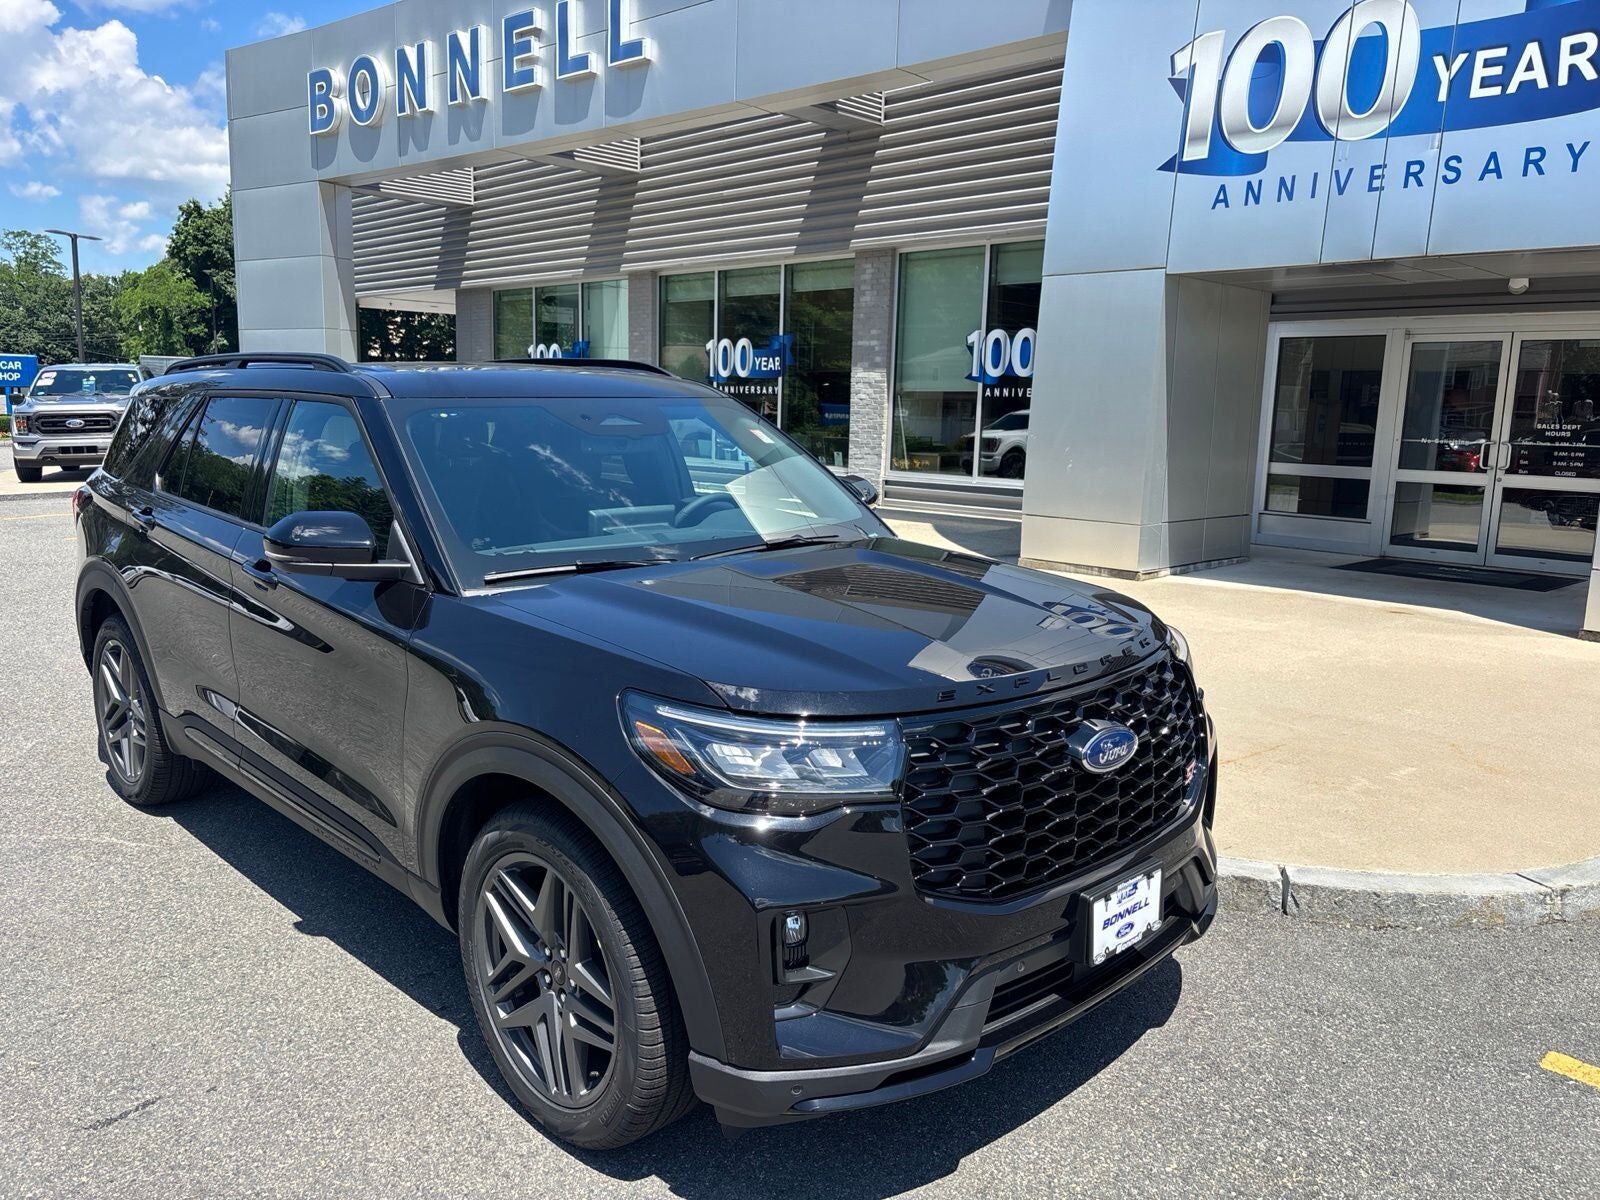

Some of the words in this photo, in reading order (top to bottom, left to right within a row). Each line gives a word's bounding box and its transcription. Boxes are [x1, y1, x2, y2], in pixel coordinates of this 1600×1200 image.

[307, 0, 652, 135] BONNELL
[1172, 0, 1420, 162] 100
[1432, 31, 1598, 103] YEAR
[1211, 140, 1591, 210] ANNIVERSARY
[0, 361, 22, 370] CAR
[705, 337, 754, 378] 100
[754, 356, 781, 371] YEAR
[970, 327, 1037, 377] 100
[936, 636, 1151, 701] EXPLORER
[1099, 735, 1129, 764] Ford
[1101, 896, 1151, 931] BONNELL
